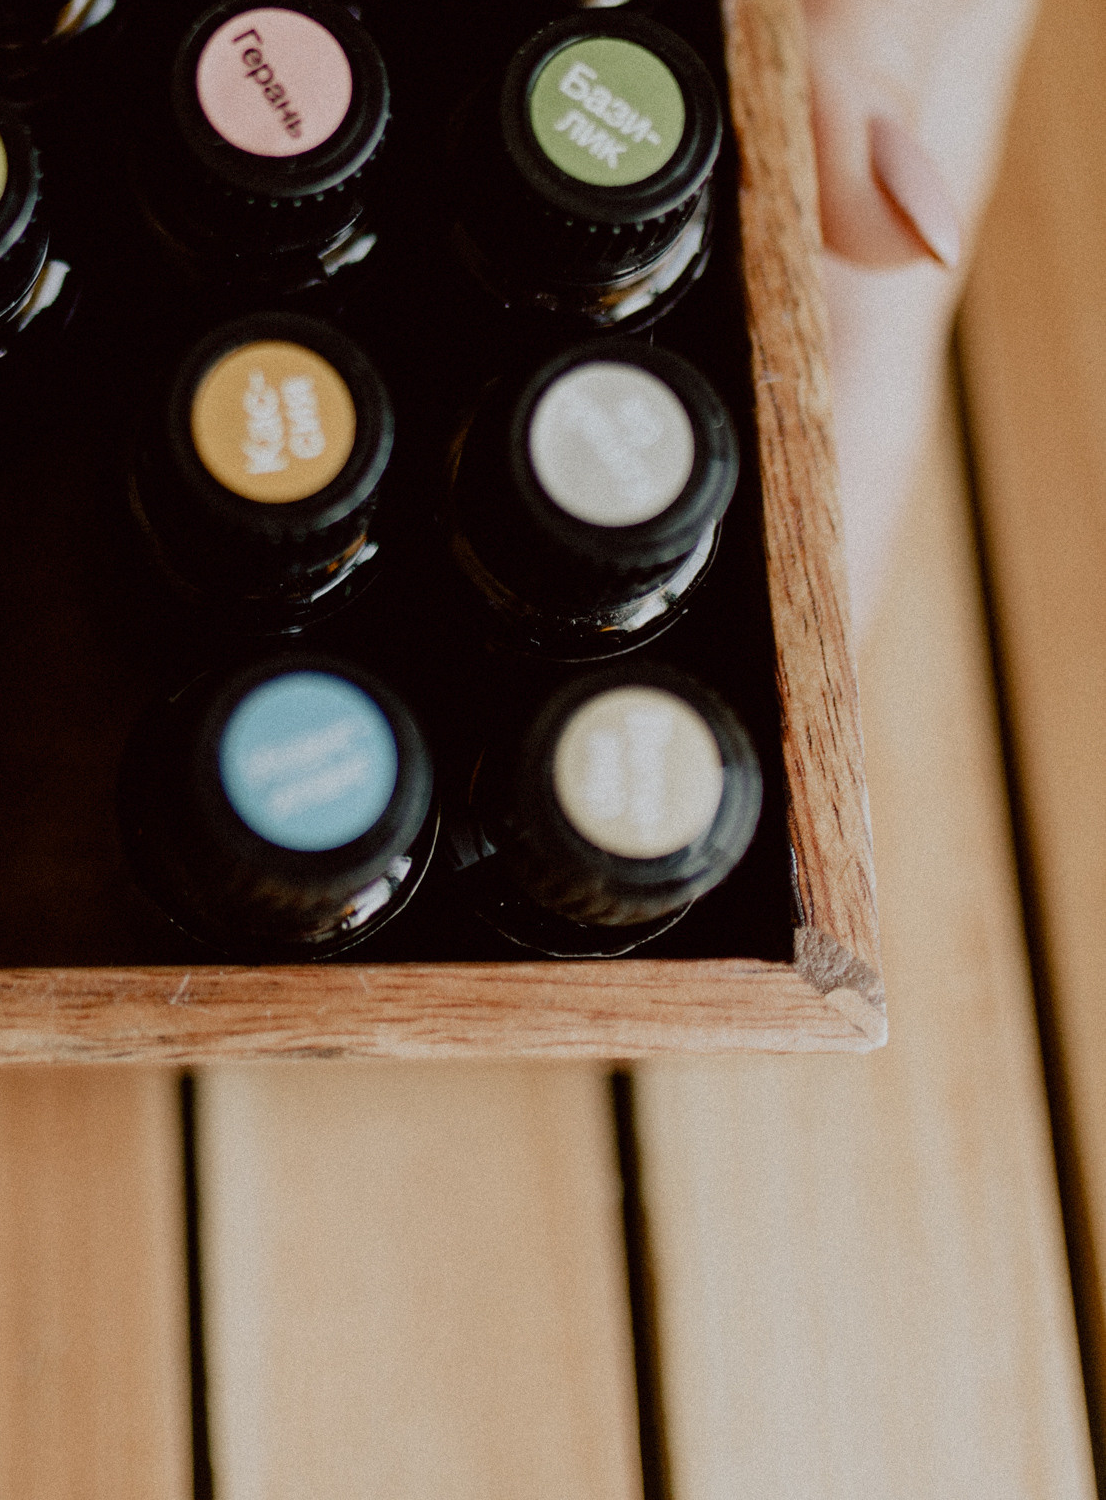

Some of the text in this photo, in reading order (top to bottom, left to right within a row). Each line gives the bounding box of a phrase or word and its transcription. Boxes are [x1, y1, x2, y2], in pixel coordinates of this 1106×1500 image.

[232, 28, 303, 140] Герань
[558, 60, 662, 146] Бази-
[553, 108, 628, 170] лик
